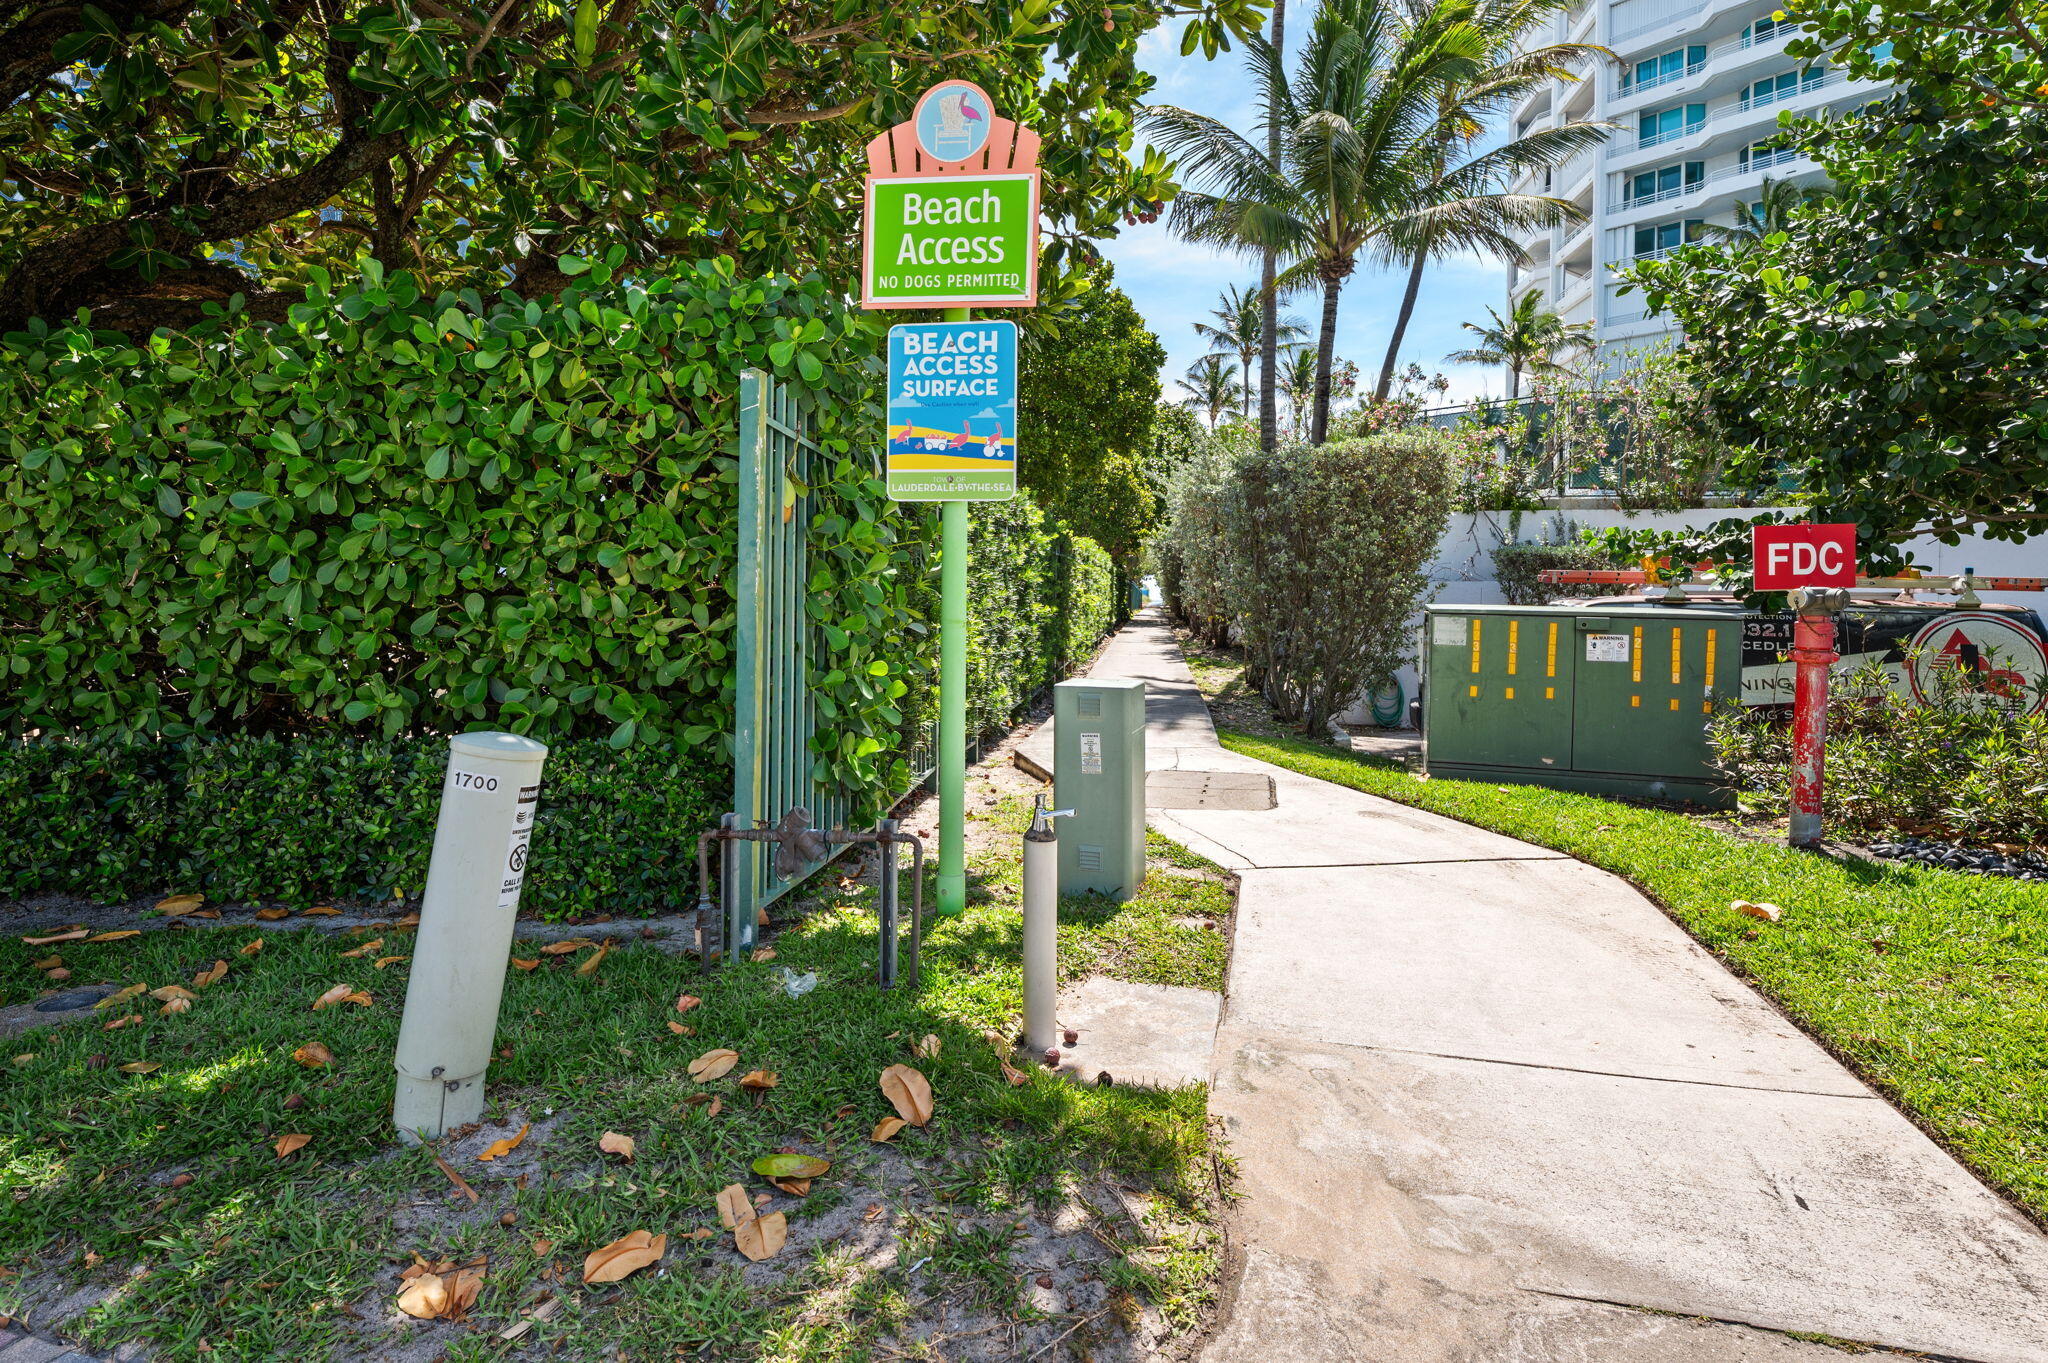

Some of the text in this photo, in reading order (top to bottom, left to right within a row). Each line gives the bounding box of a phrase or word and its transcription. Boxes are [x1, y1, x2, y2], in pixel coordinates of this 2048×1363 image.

[903, 188, 1001, 225] Beach
[896, 232, 1005, 266] Access
[879, 272, 1020, 289] NO DOGS PERMITTED
[903, 330, 998, 355] BEACH
[903, 355, 999, 377] ACCESS
[902, 378, 999, 398] SURFACE
[1768, 541, 1843, 576] FDC
[454, 772, 498, 791] 1700
[504, 878, 516, 887] CALL
